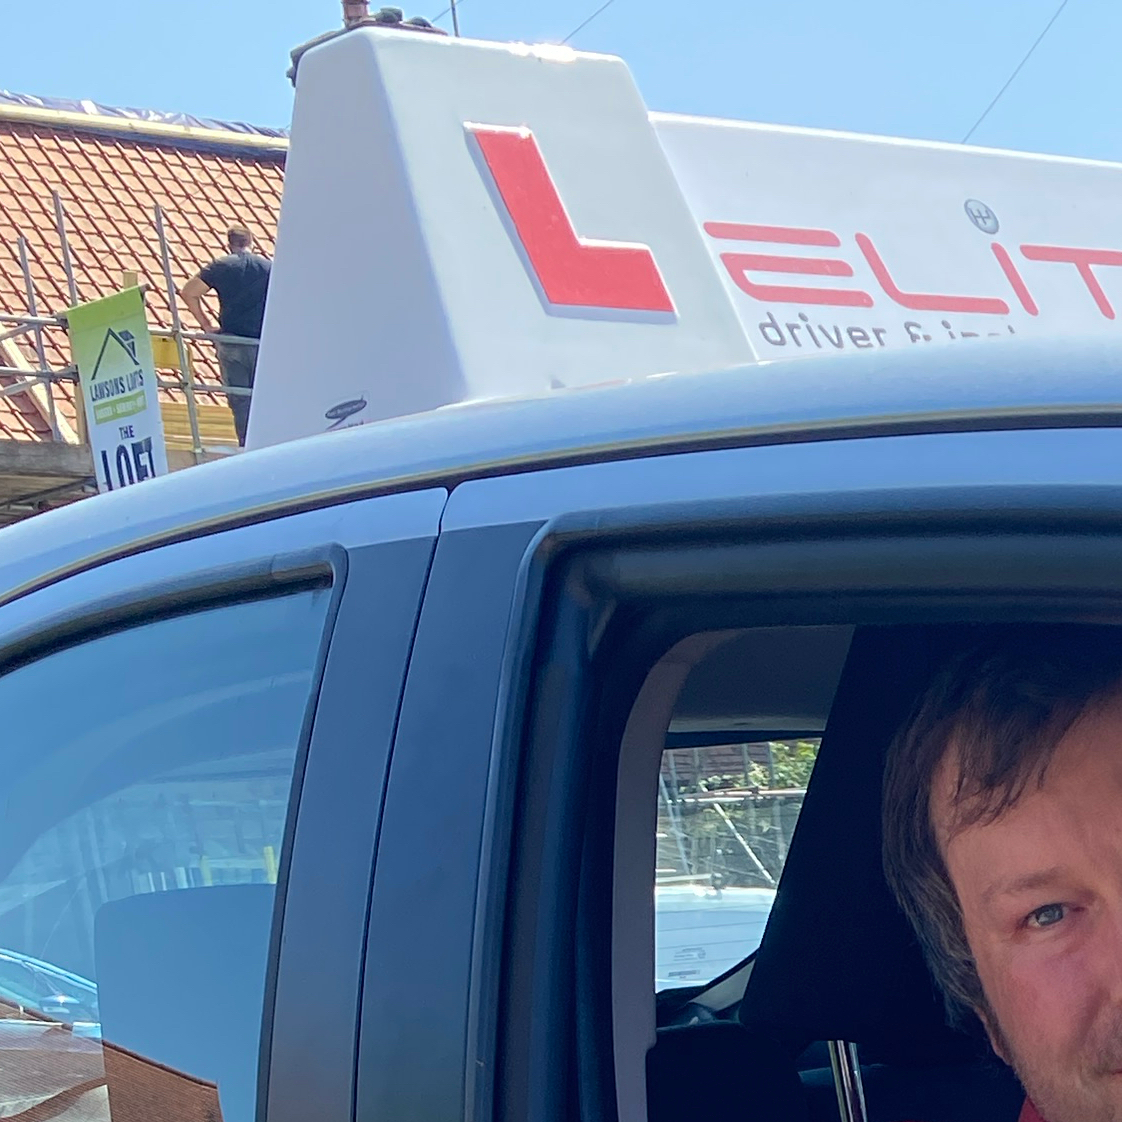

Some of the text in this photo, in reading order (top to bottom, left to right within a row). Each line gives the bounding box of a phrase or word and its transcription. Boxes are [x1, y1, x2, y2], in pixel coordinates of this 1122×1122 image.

[468, 125, 677, 317] L
[758, 311, 886, 348] driver
[119, 425, 135, 440] THE
